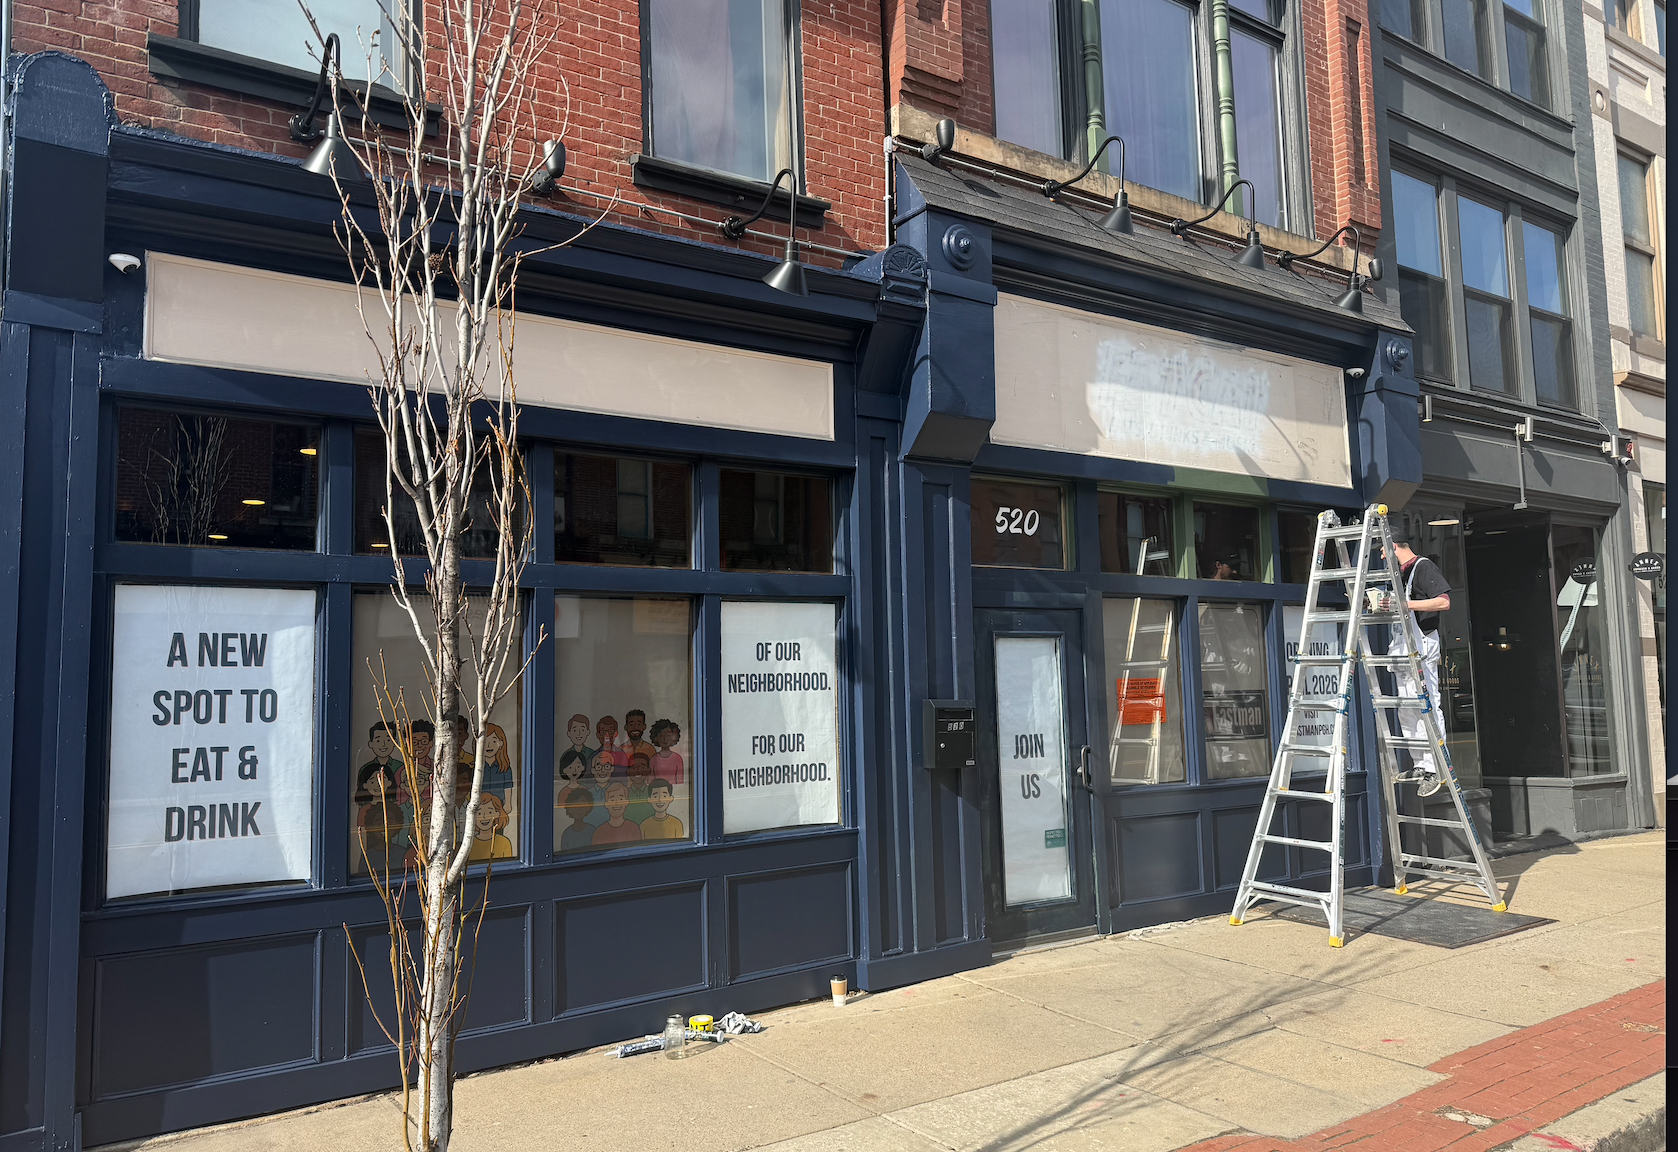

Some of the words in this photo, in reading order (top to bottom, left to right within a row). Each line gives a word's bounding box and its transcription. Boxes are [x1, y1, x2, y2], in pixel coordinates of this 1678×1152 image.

[996, 507, 1039, 535] 520
[167, 633, 188, 667] A
[198, 632, 267, 667] NEW
[756, 642, 772, 662] OF
[775, 642, 801, 662] OUR
[1286, 641, 1329, 662] OPING
[728, 673, 831, 694] NEIGHBORHOOD.
[1312, 674, 1338, 695] 2026
[152, 689, 232, 726] SPOT
[240, 689, 278, 723] TO
[752, 735, 775, 755] FOR
[778, 733, 805, 754] OUR
[1013, 733, 1045, 760] JOIN
[171, 747, 229, 783] EAT
[238, 745, 258, 780] &
[728, 763, 831, 789] NEIGHBORHOOD.
[1021, 774, 1041, 800] US
[164, 801, 261, 842] DRINK
